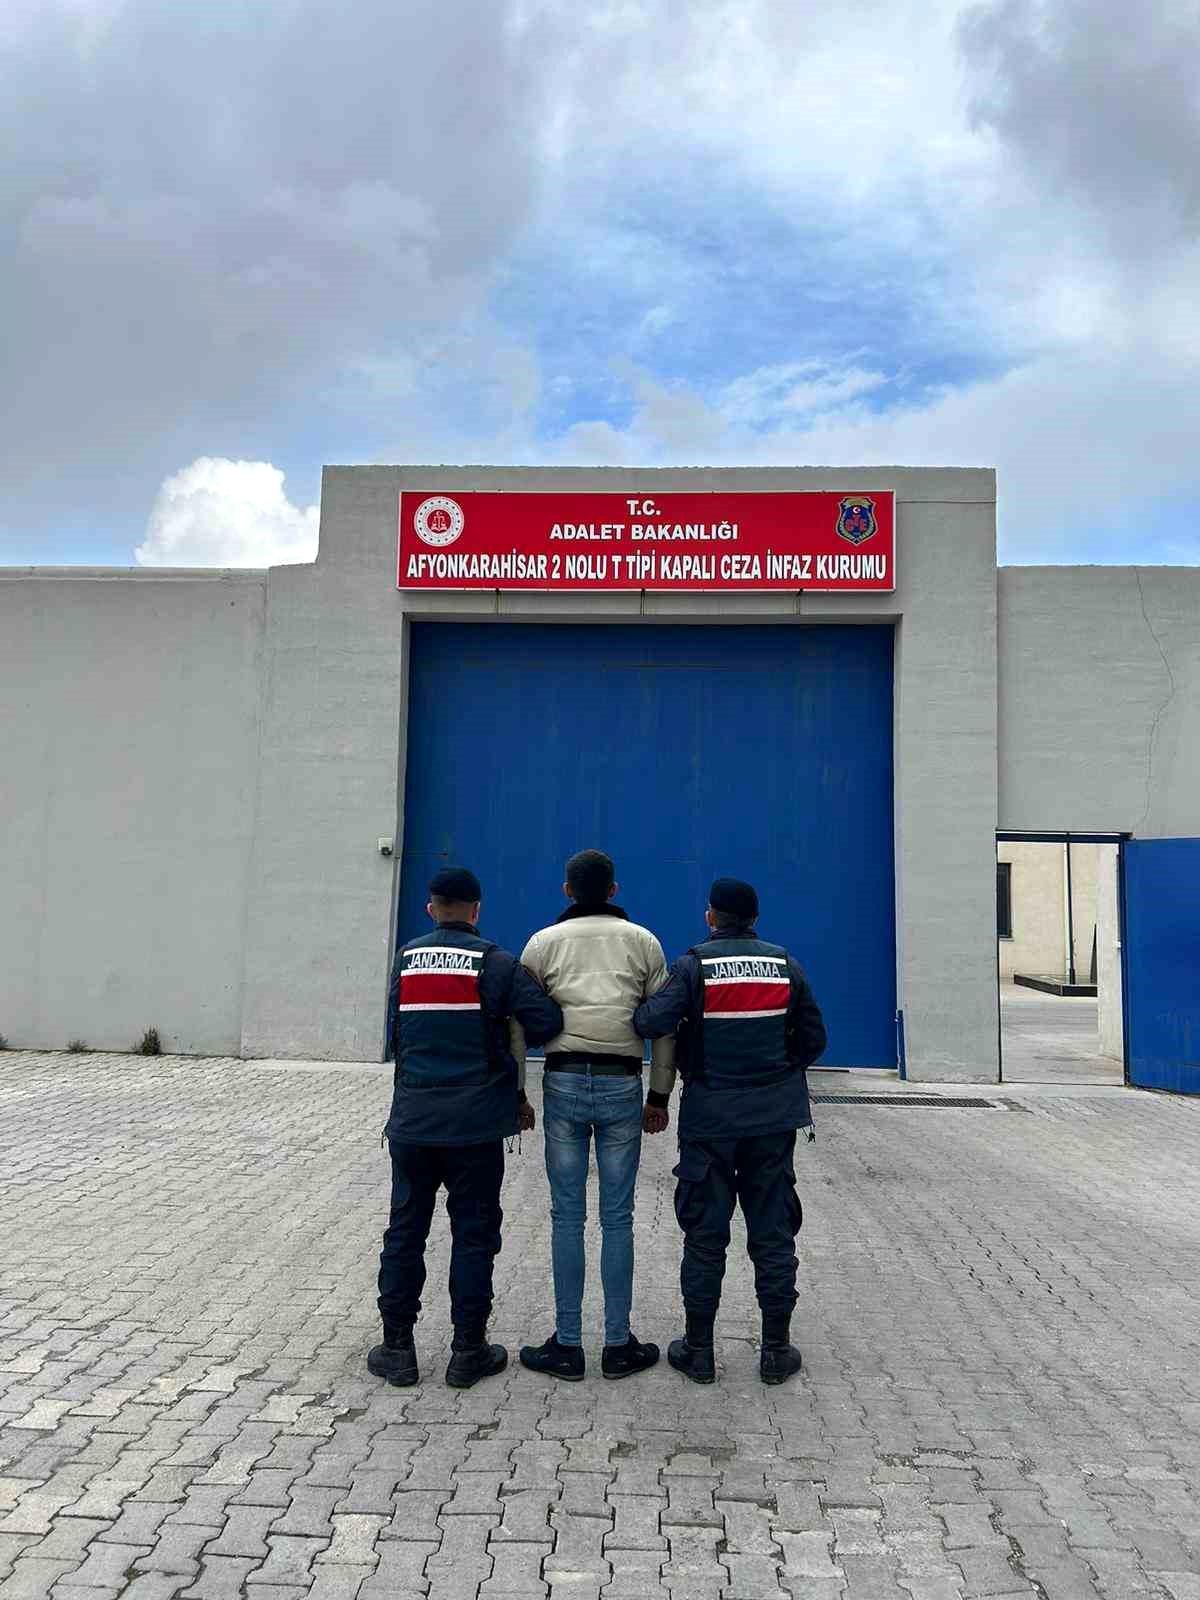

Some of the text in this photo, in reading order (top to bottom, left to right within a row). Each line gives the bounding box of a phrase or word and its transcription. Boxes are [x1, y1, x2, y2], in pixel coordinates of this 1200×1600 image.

[626, 499, 661, 516] T.C.
[550, 520, 739, 540] ADALET BAKANLIĞI
[407, 548, 887, 580] AFYONKARAHİSAR 2 NOLU T TİPİ KAPALI CEZA İNFAZ KURUMU
[407, 951, 473, 971] JANDARMA
[711, 961, 781, 979] JANDARMA
